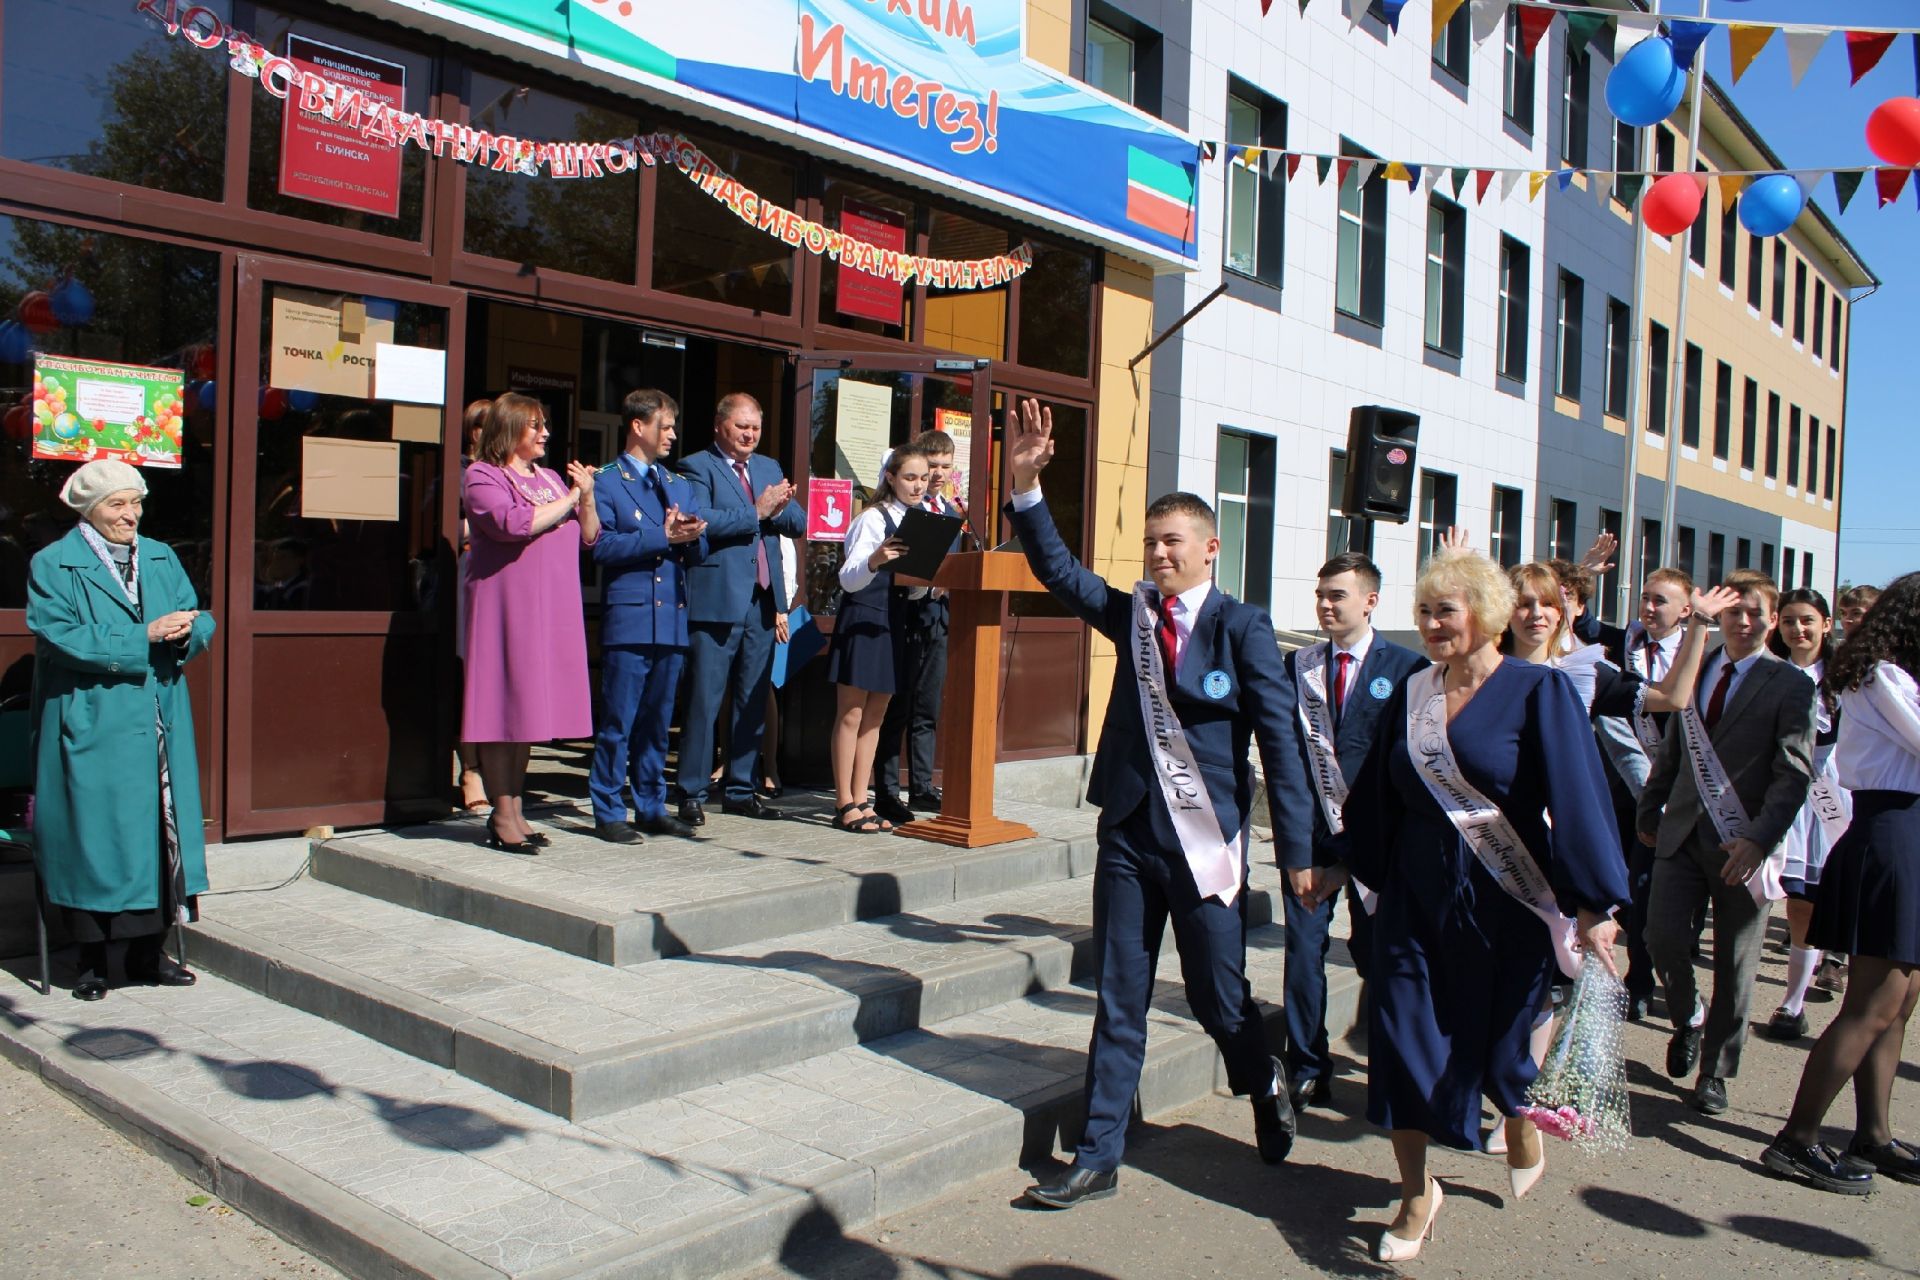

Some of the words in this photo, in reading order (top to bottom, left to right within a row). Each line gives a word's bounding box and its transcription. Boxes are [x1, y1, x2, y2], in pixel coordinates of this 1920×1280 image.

[313, 56, 381, 80] МУНИЦИПАЛЬНОЕ
[801, 14, 998, 154] Итегез!
[260, 58, 517, 173] СВИДАНИЯ
[840, 233, 902, 282] ВАМ
[325, 144, 370, 162] БУИНСКА
[283, 346, 324, 361] ТОЧКА
[1165, 759, 1203, 812] 2024
[1812, 787, 1841, 821] 2024
